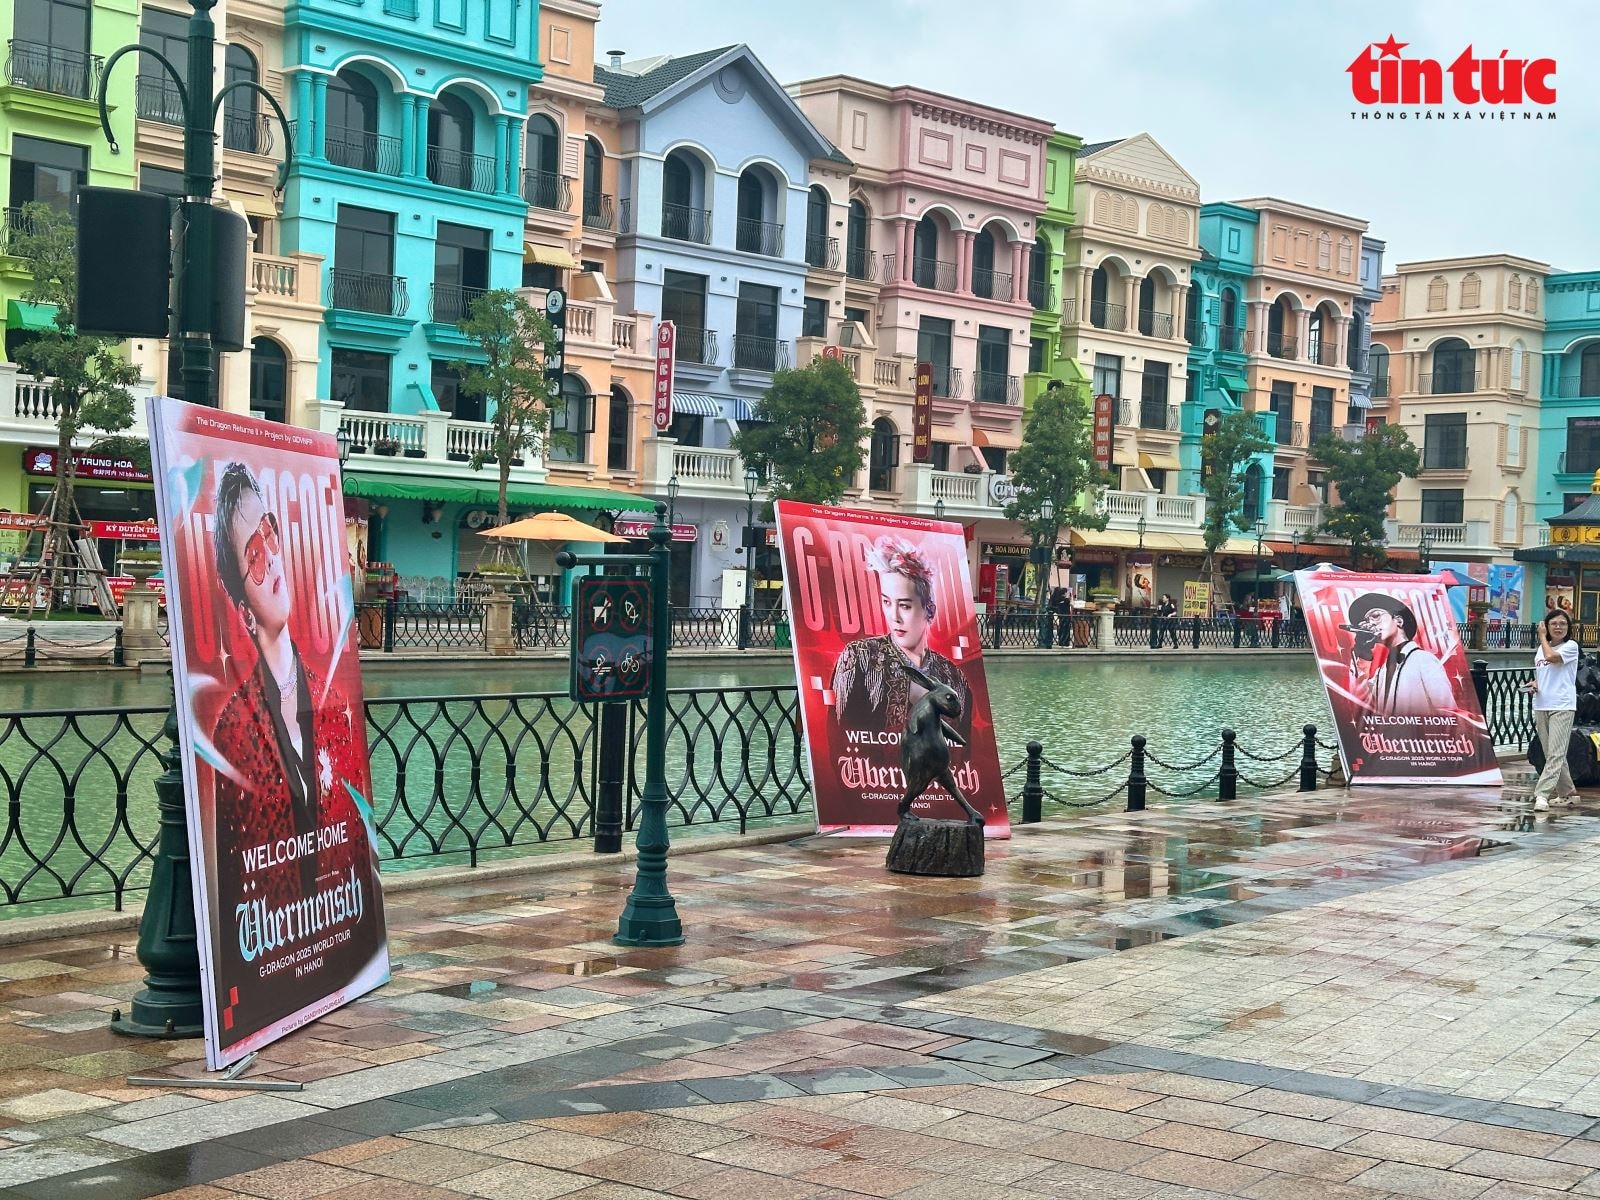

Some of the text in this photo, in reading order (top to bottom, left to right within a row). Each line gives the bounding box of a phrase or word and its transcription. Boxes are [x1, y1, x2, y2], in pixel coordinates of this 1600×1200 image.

[196, 416, 209, 426] The
[209, 419, 232, 431] Dragon
[232, 423, 255, 435] Returns
[264, 430, 284, 443] Project
[285, 434, 293, 443] by
[81, 457, 112, 467] TRUNG
[113, 460, 133, 468] HOA
[824, 509, 846, 517] Dragon
[1362, 715, 1458, 726] WELCOME HOME
[845, 730, 902, 745] WELCO
[1359, 726, 1475, 757] Übermensch
[861, 792, 899, 800] G-DRAGON
[242, 822, 349, 874] WELCOME HOME
[236, 863, 363, 962] Übermensch
[259, 929, 351, 978] G-DRAGON 2025 WORLD TOUR
[295, 958, 324, 979] IN HANOI
